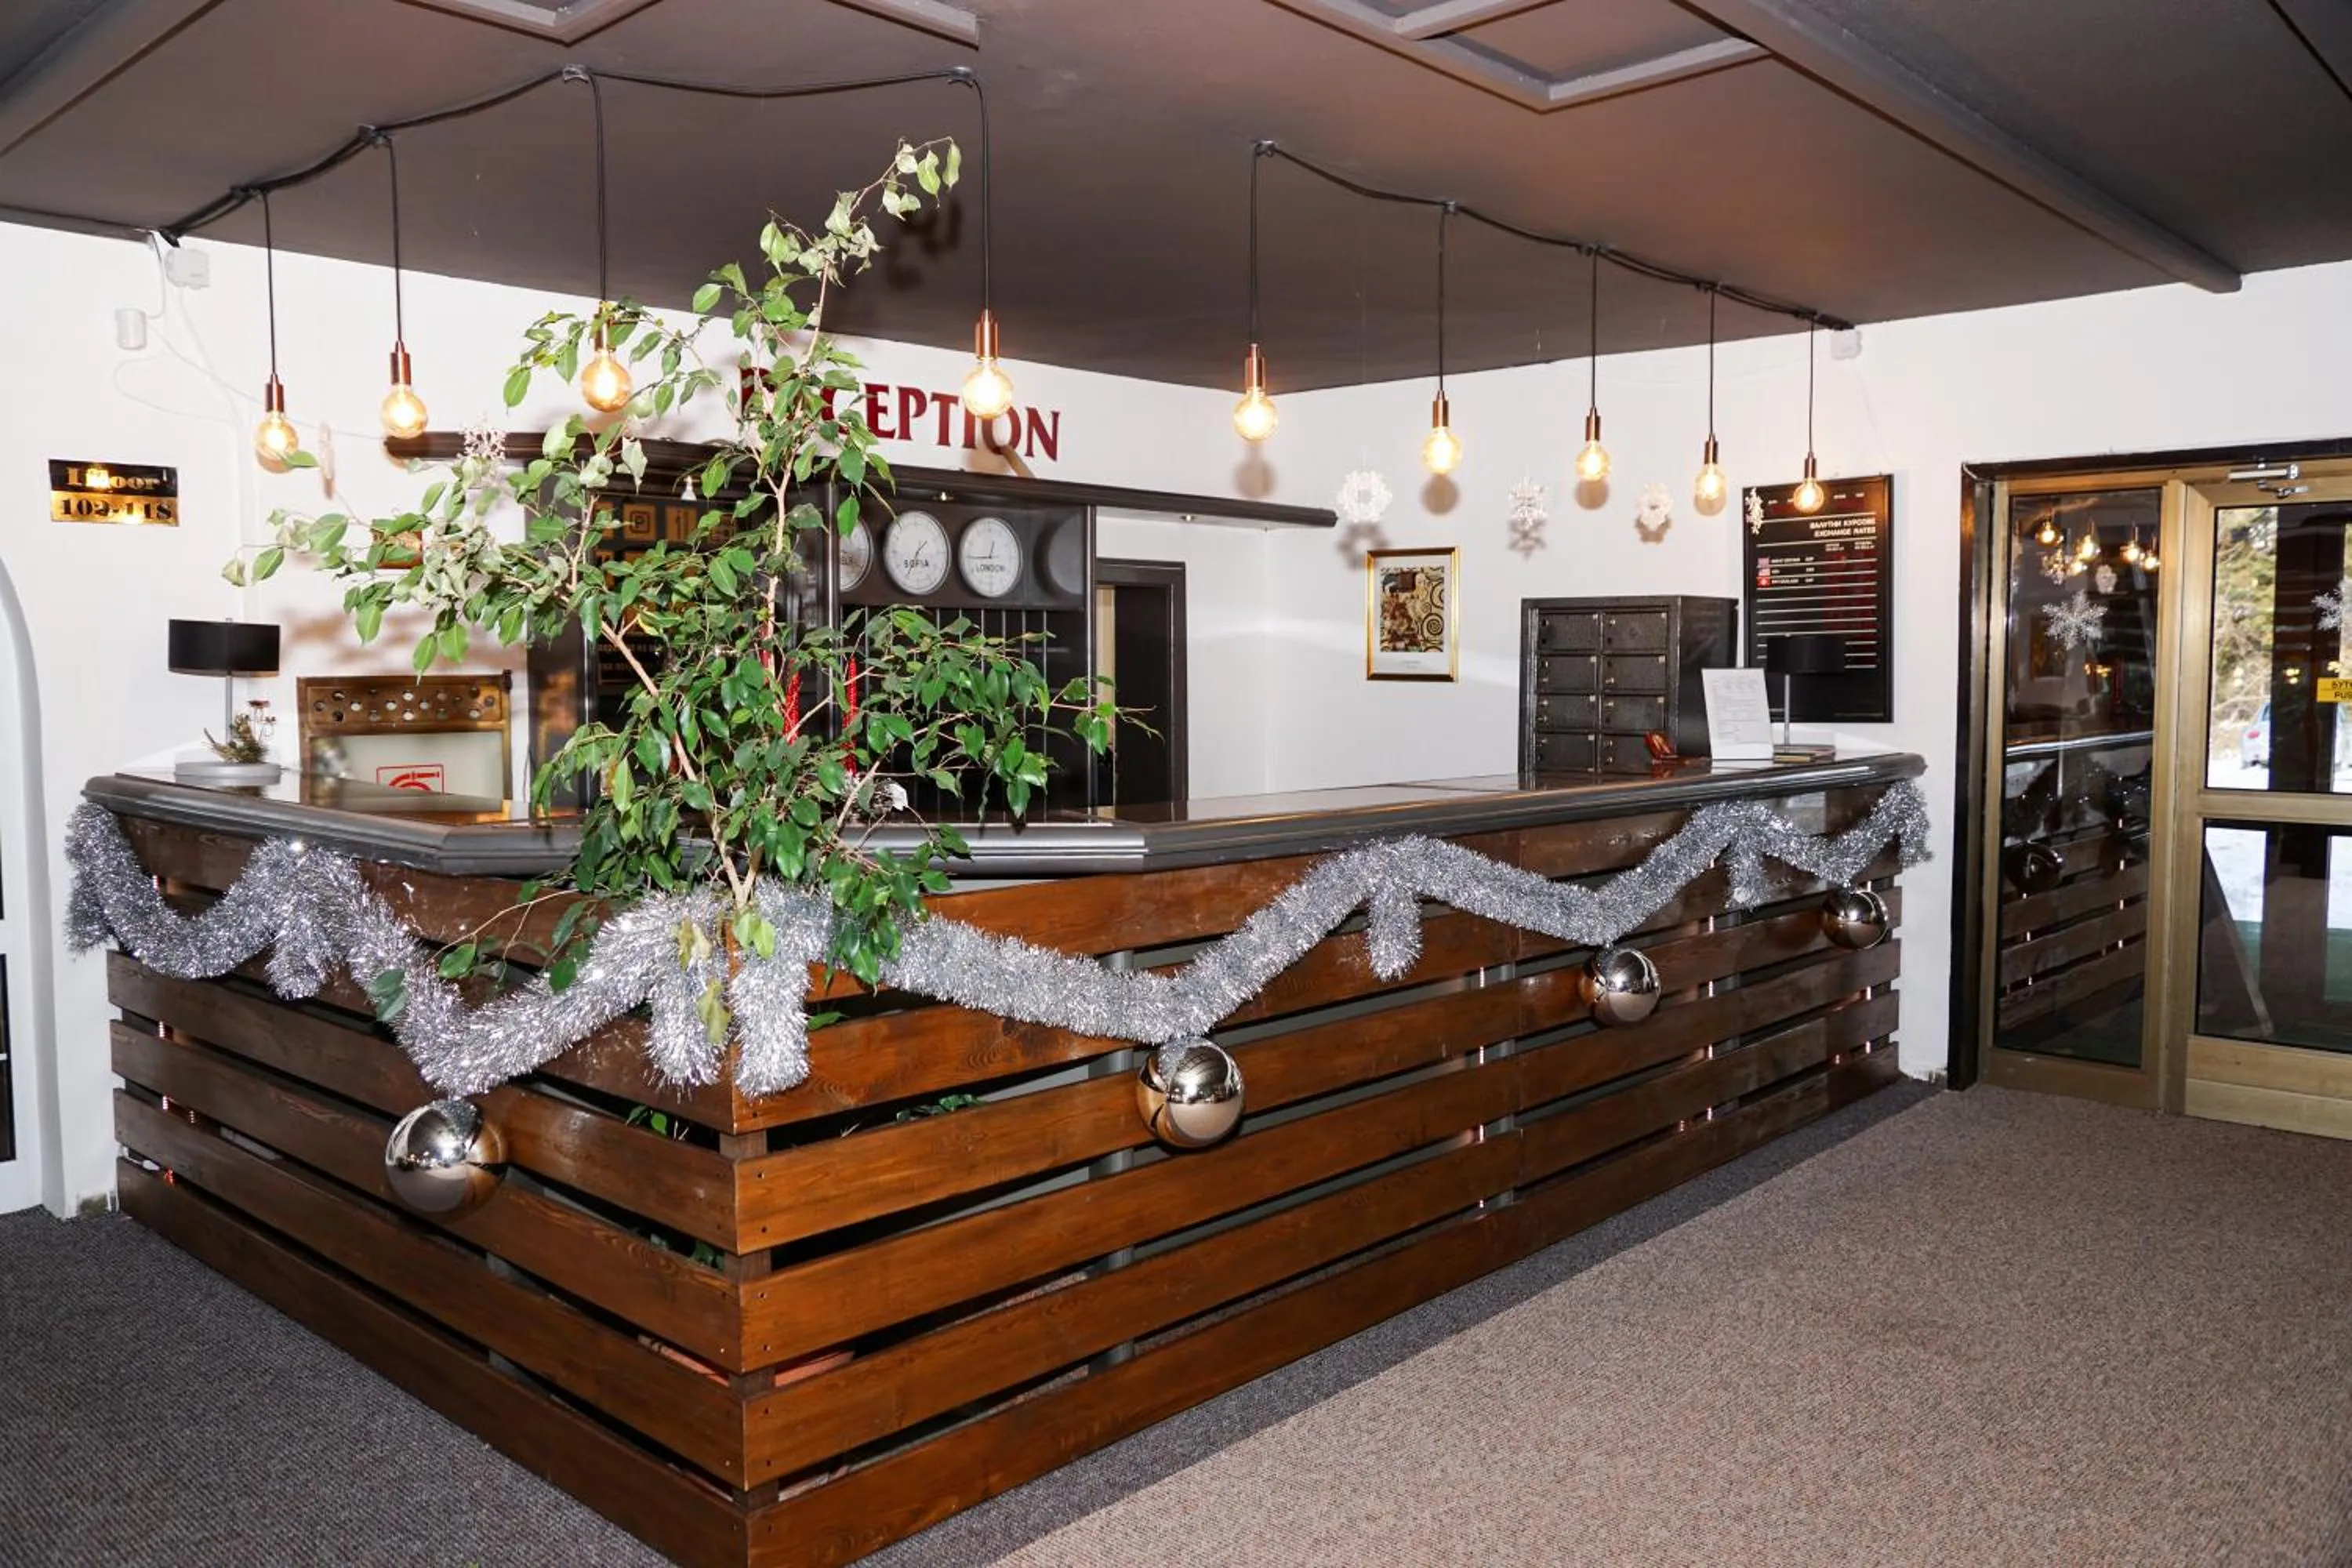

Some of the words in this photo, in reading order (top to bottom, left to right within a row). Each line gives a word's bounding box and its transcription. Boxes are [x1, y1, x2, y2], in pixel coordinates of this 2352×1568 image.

[740, 366, 1060, 463] EPTION
[85, 468, 160, 490] oor
[1813, 528, 1852, 538] EXCHANGE
[904, 559, 929, 568] SOFIA
[976, 564, 1005, 573] LONDON
